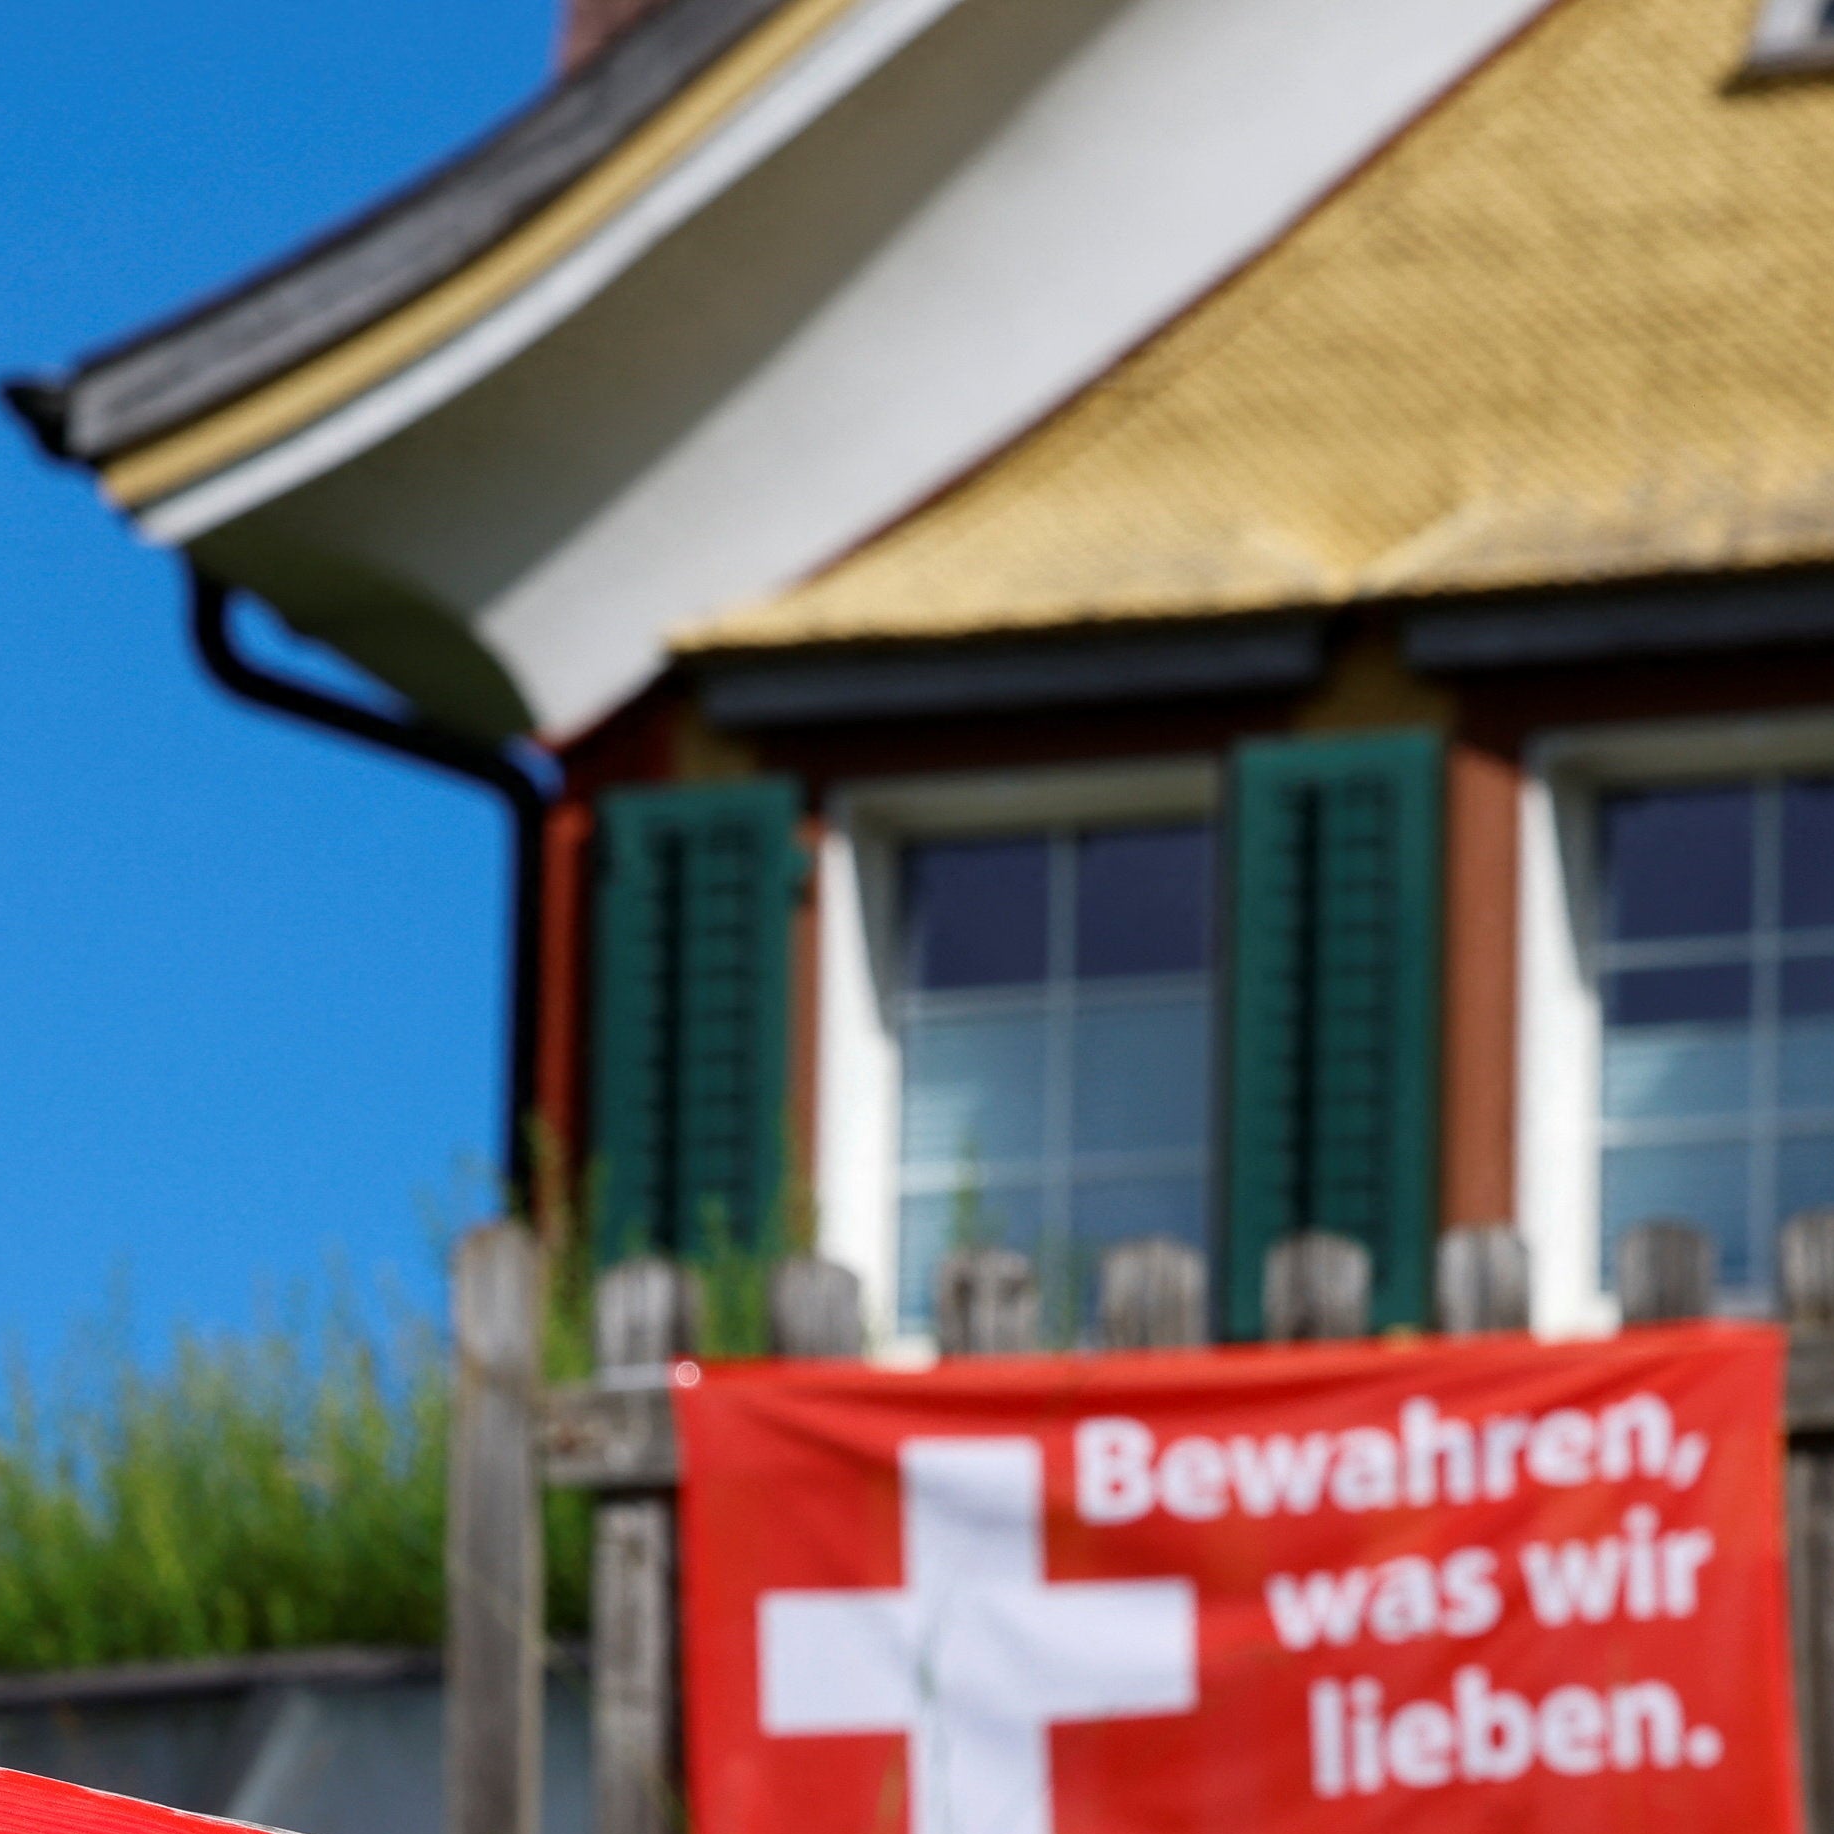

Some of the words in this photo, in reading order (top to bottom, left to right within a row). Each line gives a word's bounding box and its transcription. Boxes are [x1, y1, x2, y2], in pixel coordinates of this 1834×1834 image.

[1073, 1392, 1708, 1524] Bewahren,
[1266, 1547, 1502, 1651] was
[1518, 1503, 1716, 1628] wir
[1309, 1665, 1723, 1798] lieben.
